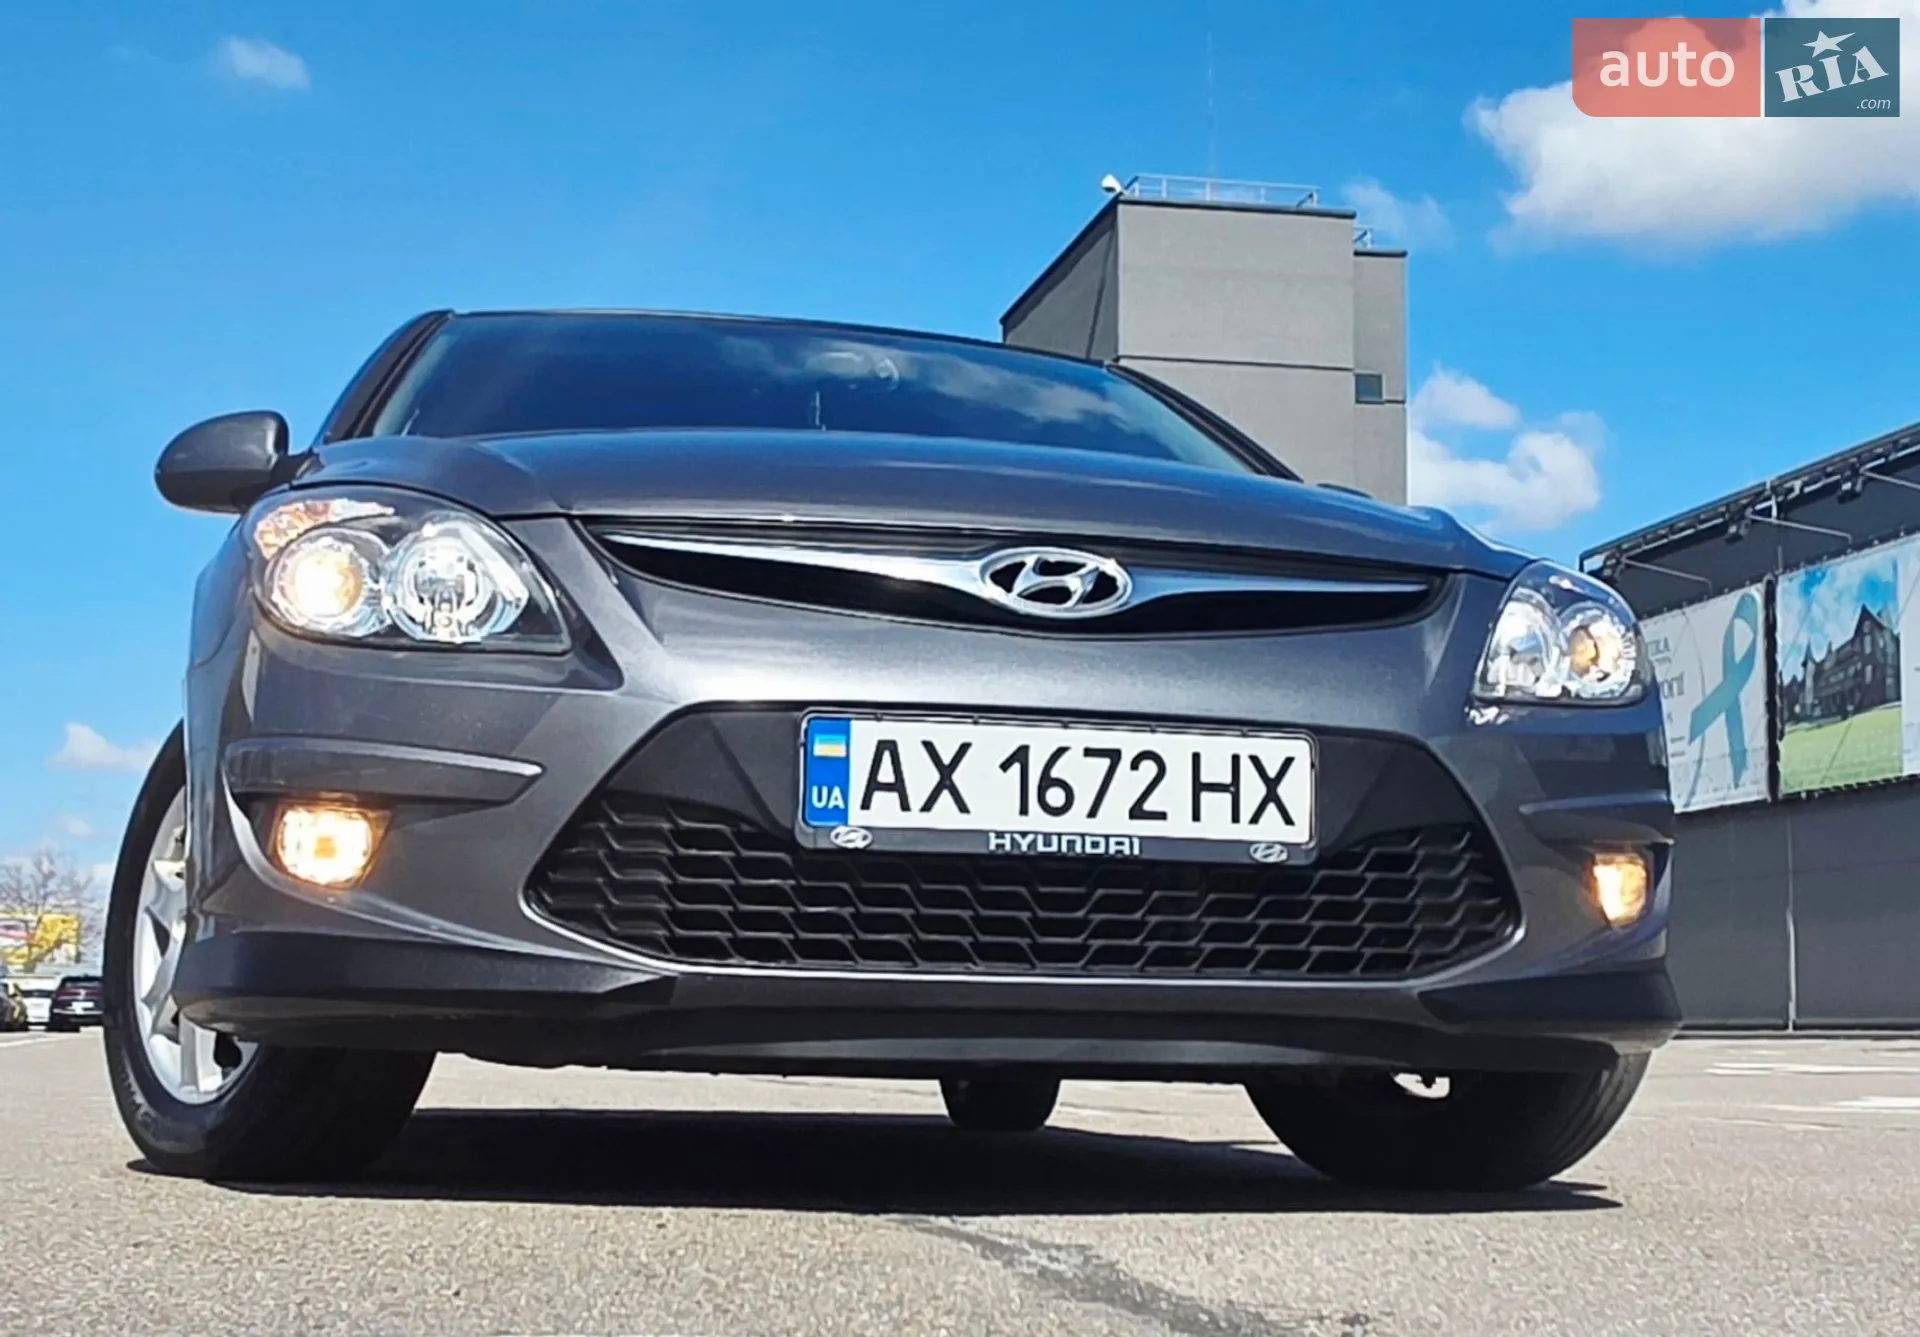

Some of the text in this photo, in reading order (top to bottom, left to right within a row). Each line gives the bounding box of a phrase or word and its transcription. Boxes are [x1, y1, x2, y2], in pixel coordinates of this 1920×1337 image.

[861, 740, 1295, 826] AX 1672 HX
[812, 786, 844, 808] UA
[988, 831, 1141, 856] HYUNDAI
